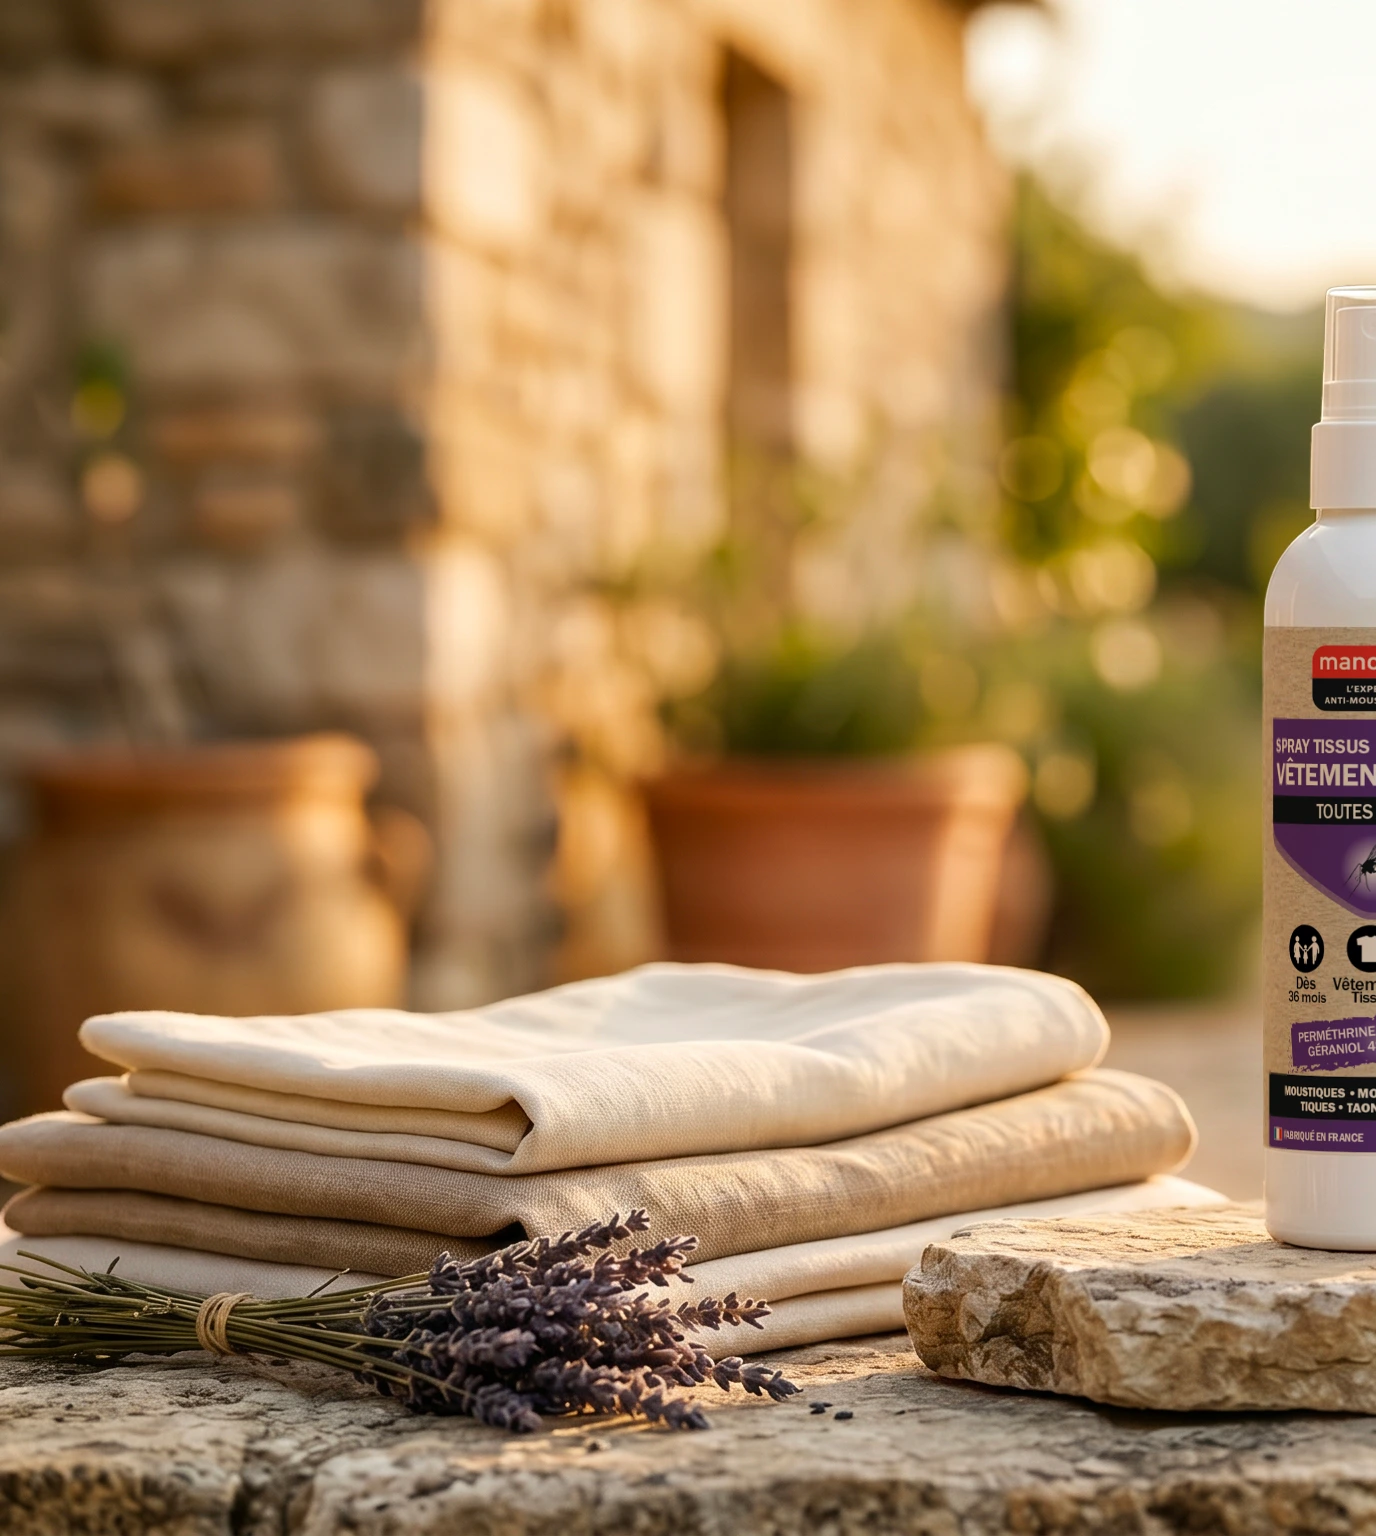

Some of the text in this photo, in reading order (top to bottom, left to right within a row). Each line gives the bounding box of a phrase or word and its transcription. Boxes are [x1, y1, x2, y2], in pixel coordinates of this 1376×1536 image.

[1276, 738, 1370, 754] SPRAY TISSUS
[1316, 803, 1373, 820] TOUTES
[1296, 976, 1316, 990] Dès
[1288, 991, 1327, 1004] 36 mois
[1298, 1025, 1376, 1043] PERMÉTHRINE
[1308, 1042, 1365, 1057] GÉRANIOL
[1284, 1085, 1346, 1100] MOUSTIQUES
[1300, 1101, 1336, 1113] TIQUES
[1316, 1132, 1326, 1142] EN
[1328, 1132, 1364, 1143] FRANCE
